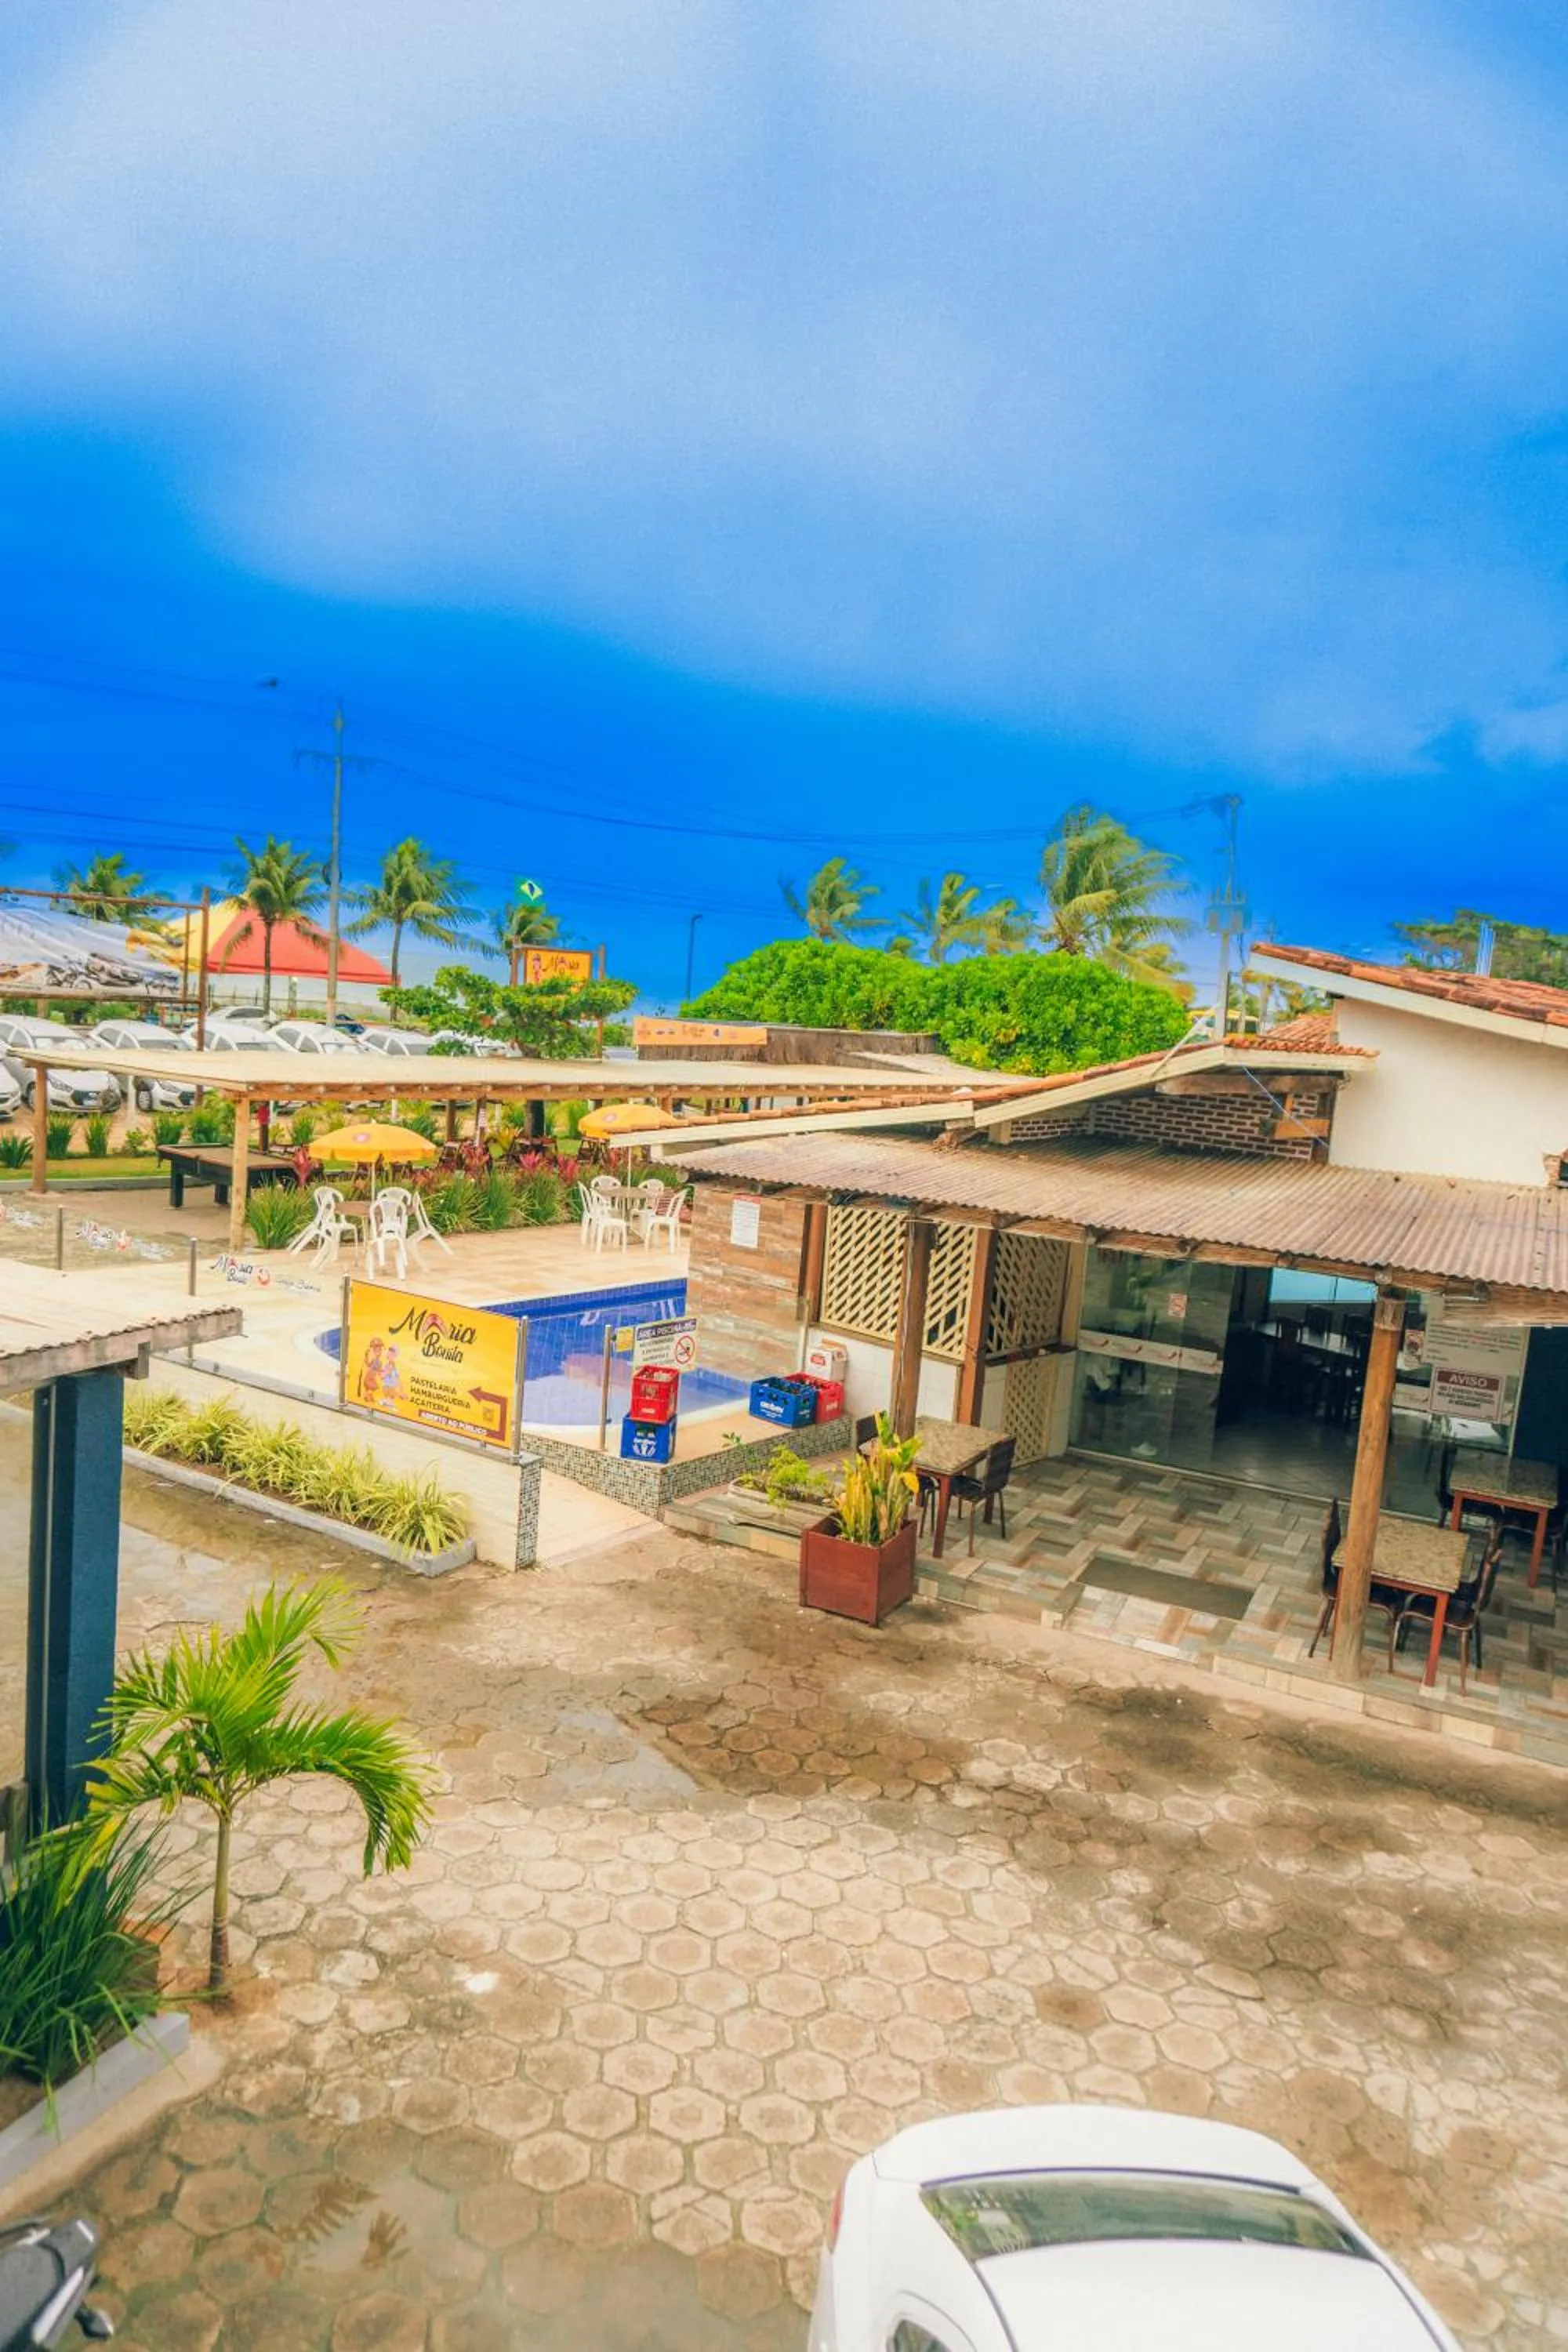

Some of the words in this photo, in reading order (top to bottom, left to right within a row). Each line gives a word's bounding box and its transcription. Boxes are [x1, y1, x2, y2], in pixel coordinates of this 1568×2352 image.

[389, 1307, 477, 1345] Maria
[422, 1332, 464, 1363] Bonita
[409, 1376, 457, 1395] PASTELARIA
[1449, 1374, 1487, 1387] AVISO
[410, 1386, 471, 1409] HAMBURGUERIA
